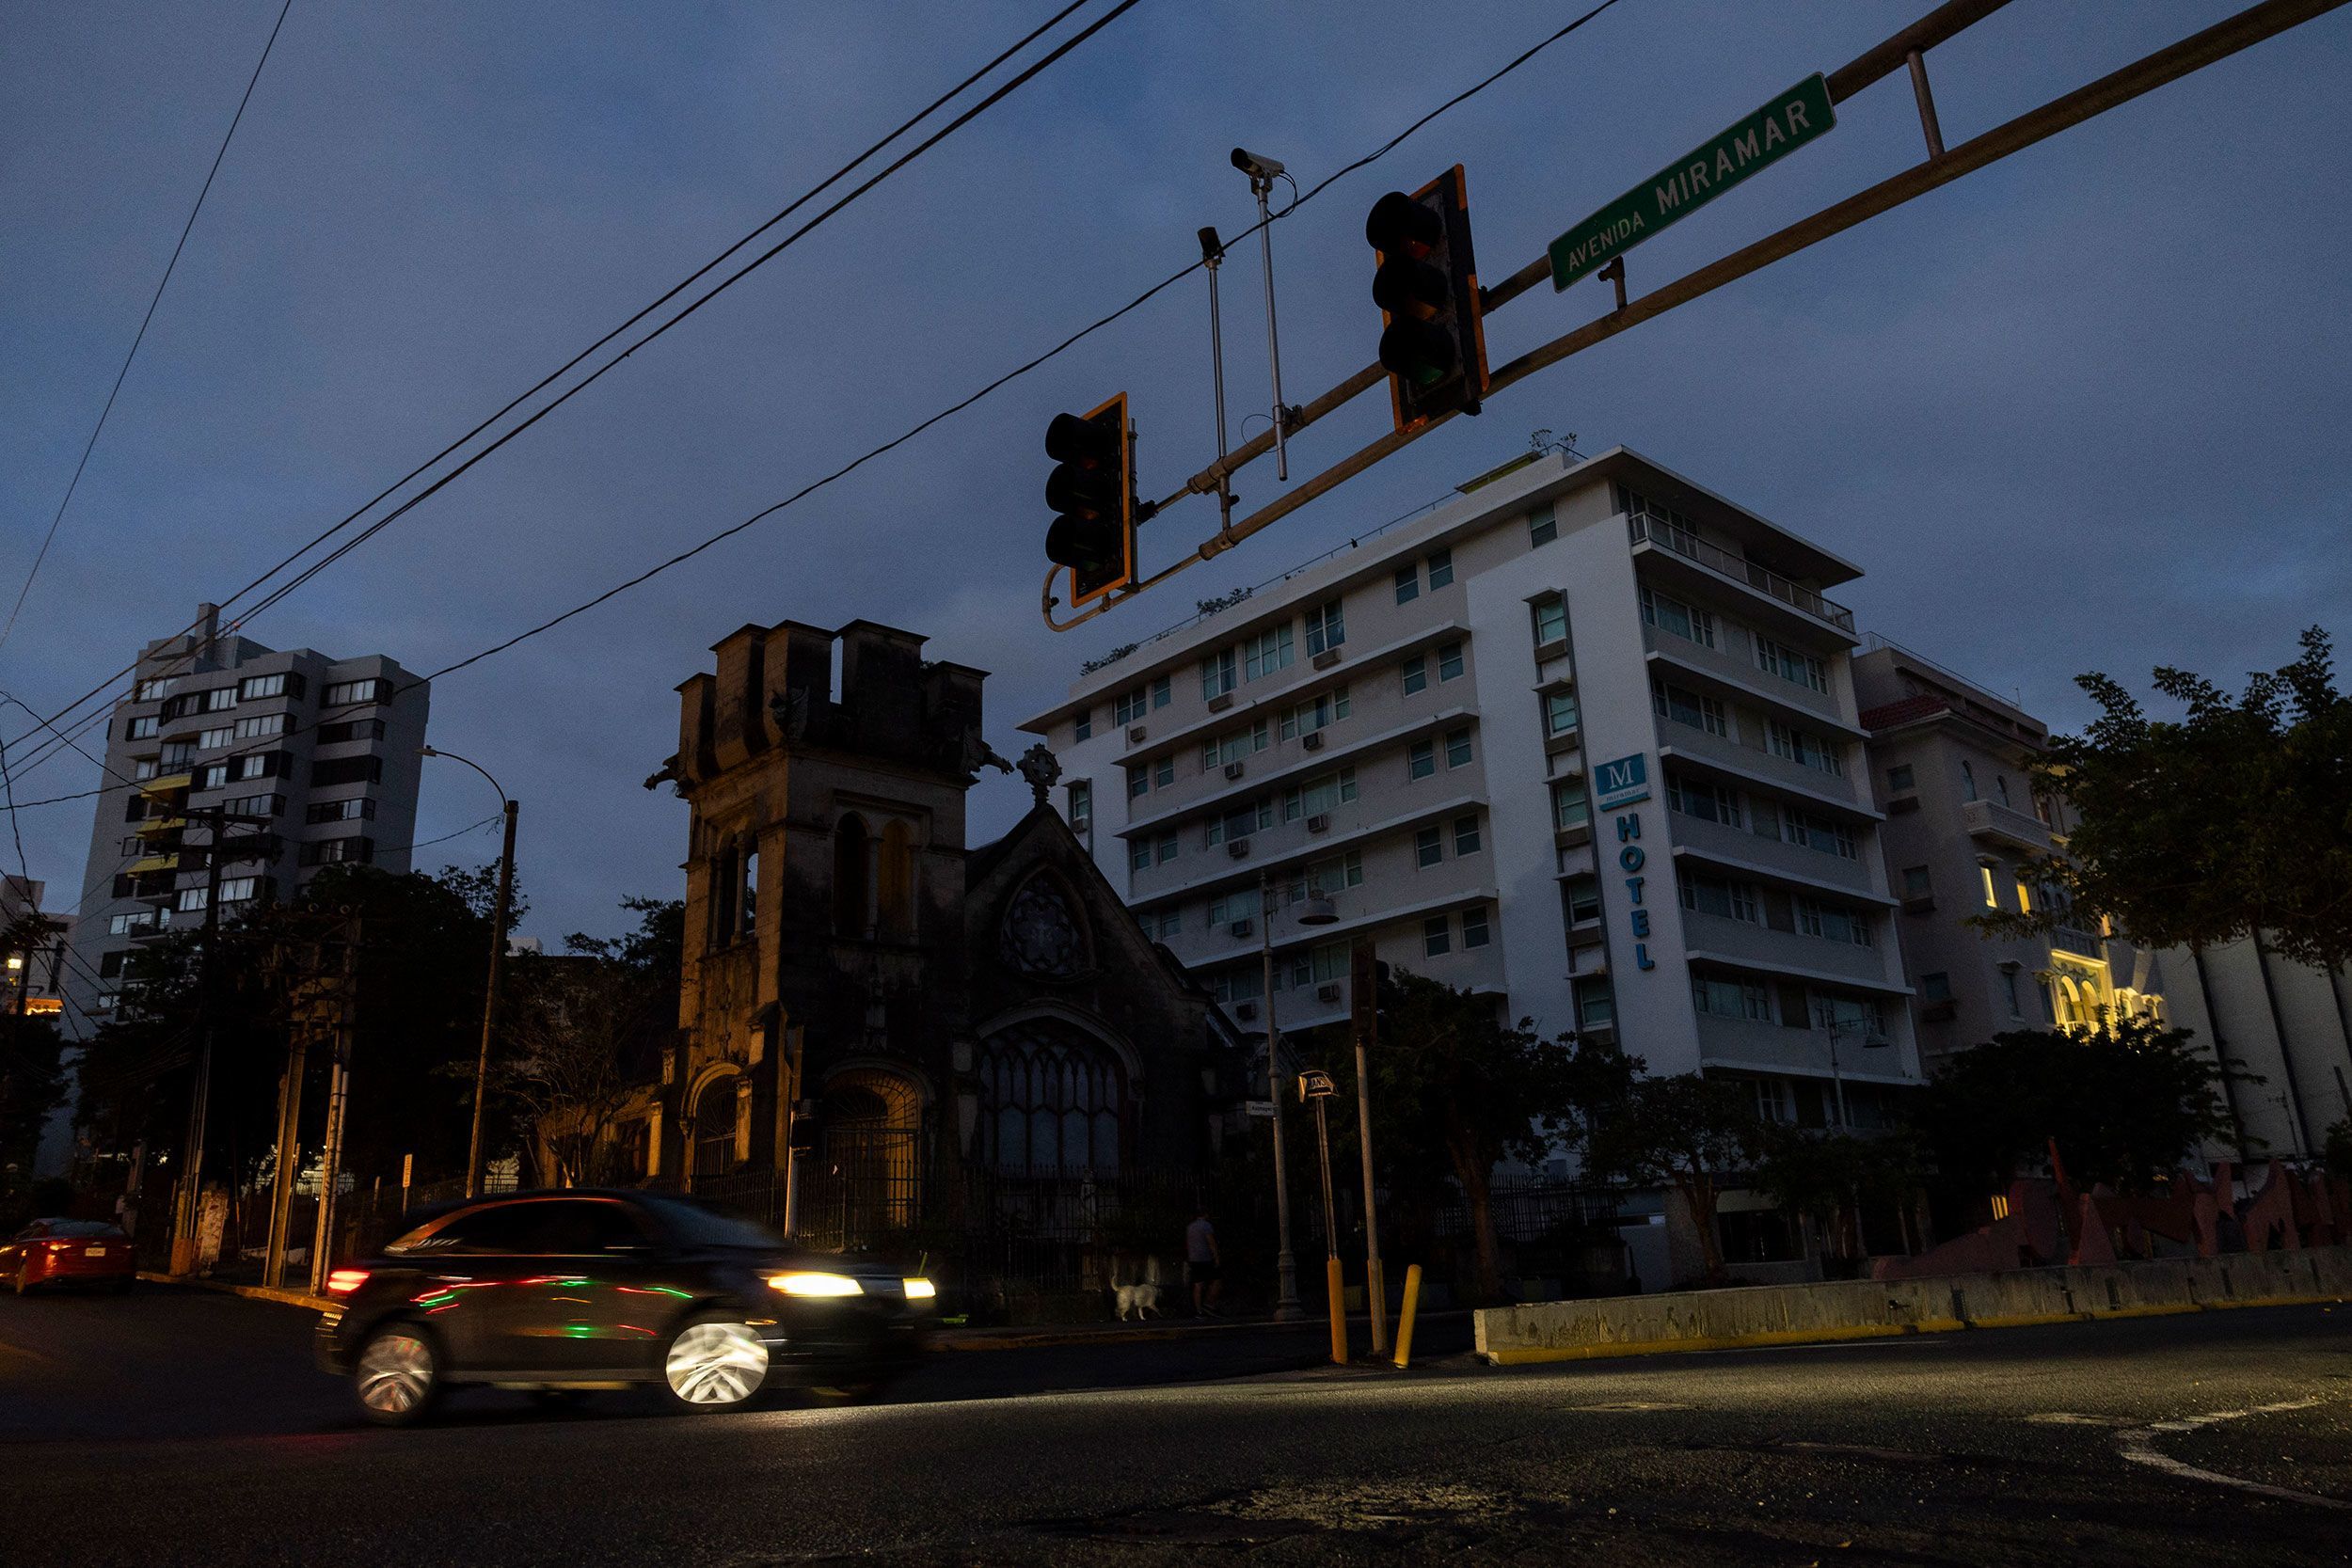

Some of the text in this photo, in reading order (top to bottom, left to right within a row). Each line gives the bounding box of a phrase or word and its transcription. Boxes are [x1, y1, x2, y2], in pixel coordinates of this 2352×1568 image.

[1568, 99, 1811, 272] AVENIDA MIRAMAR
[1607, 760, 1635, 790] M
[1616, 813, 1655, 971] HOTEL
